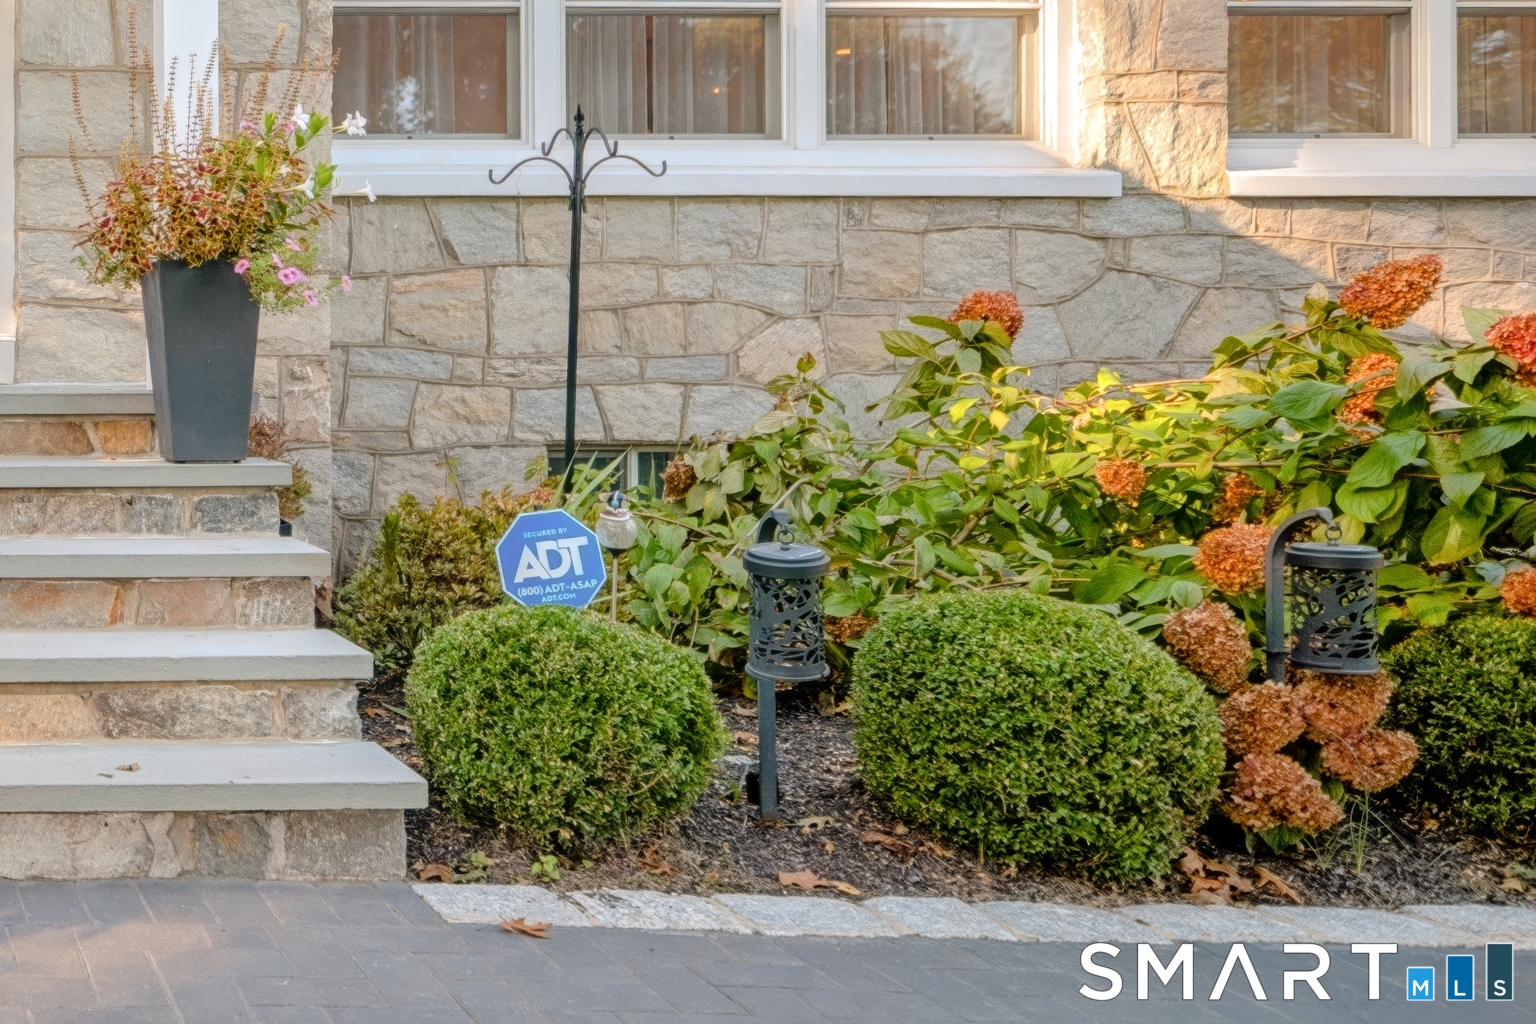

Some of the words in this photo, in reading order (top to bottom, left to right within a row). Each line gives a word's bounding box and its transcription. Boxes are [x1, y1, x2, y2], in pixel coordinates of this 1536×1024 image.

[523, 528, 556, 538] SECURED
[514, 536, 588, 583] ADT
[517, 584, 544, 598] (800)
[545, 579, 597, 593] ADT-ASAP
[541, 592, 577, 603] ADT.COM
